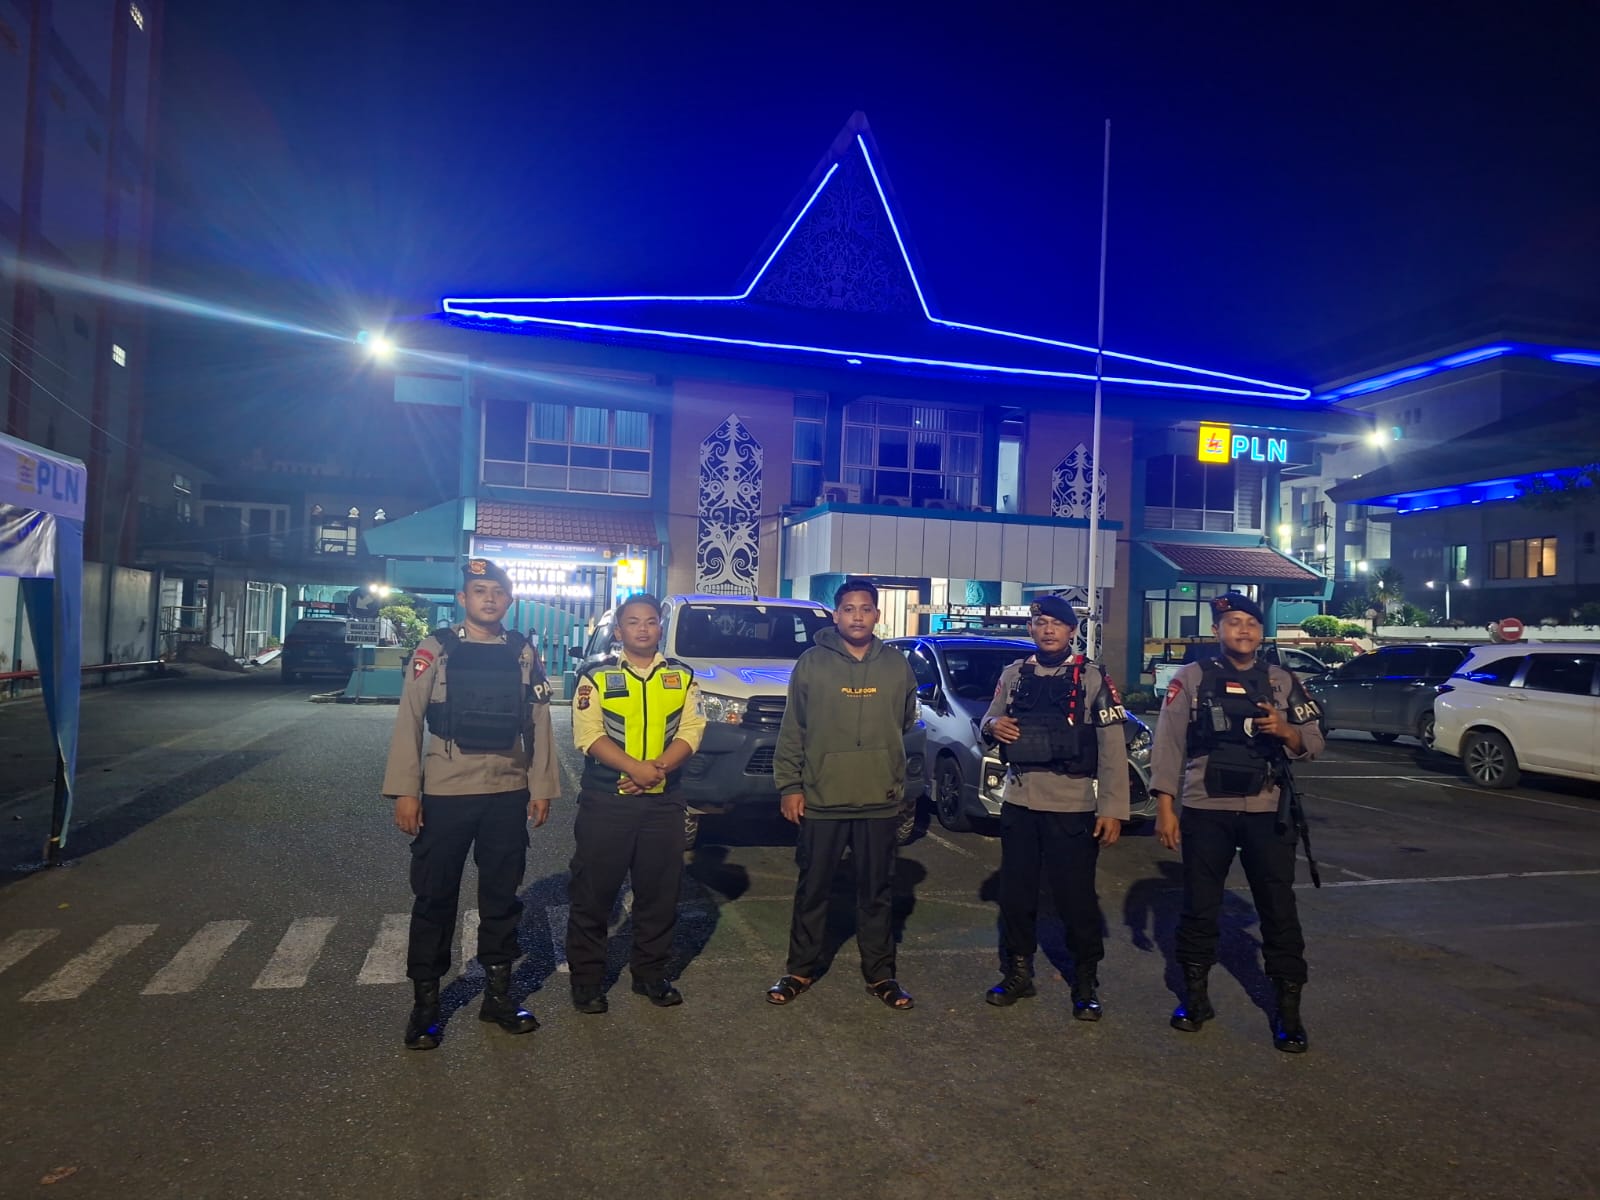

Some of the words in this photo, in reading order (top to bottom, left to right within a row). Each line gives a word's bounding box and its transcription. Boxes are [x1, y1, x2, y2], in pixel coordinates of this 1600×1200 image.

[1231, 434, 1288, 463] PLN
[37, 459, 79, 504] PLN
[506, 568, 566, 583] CENTER
